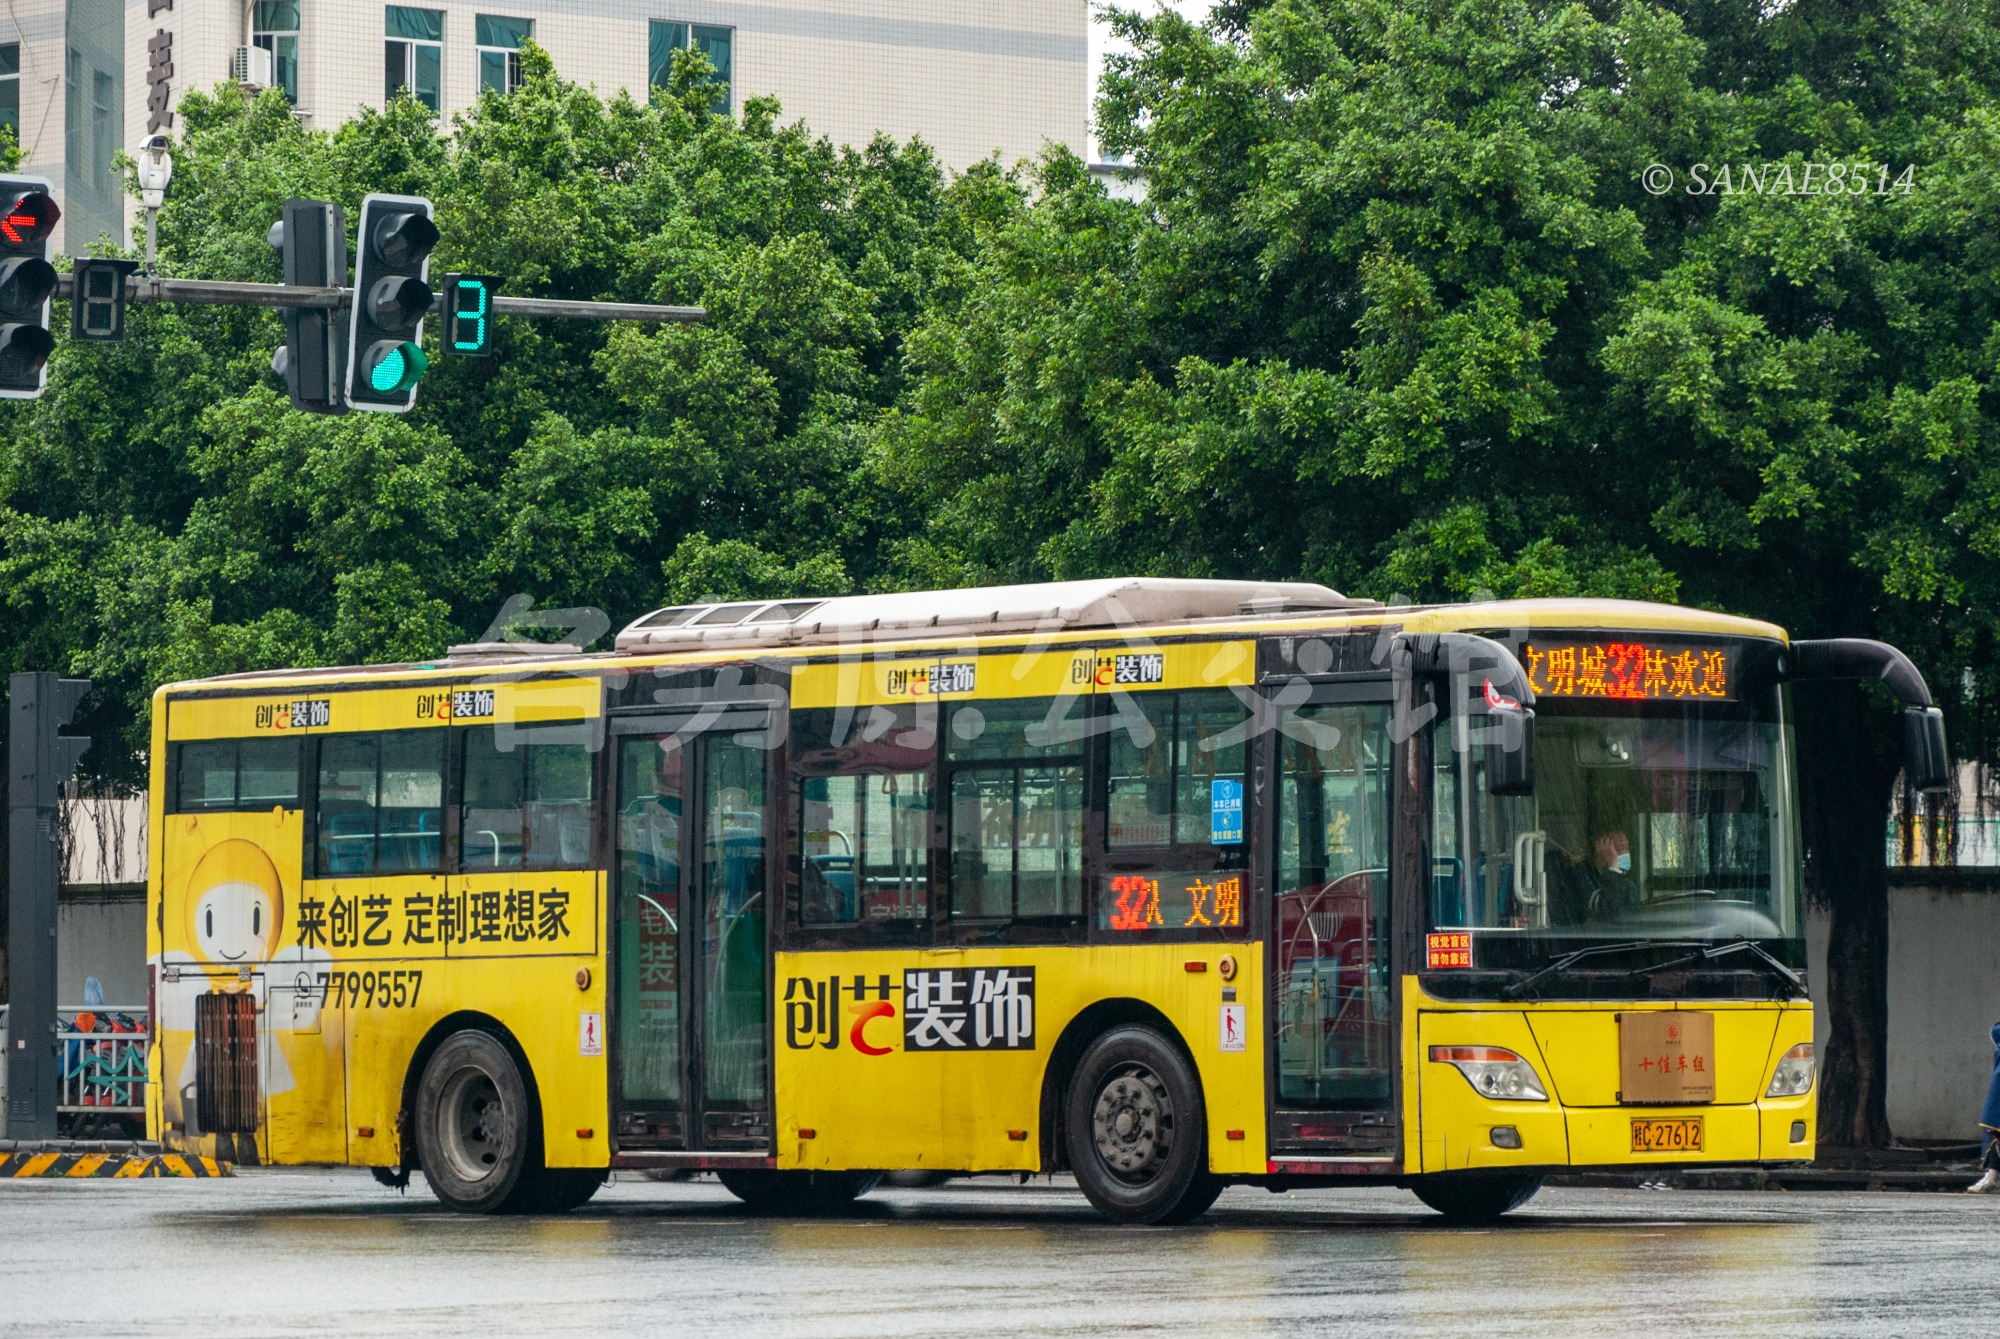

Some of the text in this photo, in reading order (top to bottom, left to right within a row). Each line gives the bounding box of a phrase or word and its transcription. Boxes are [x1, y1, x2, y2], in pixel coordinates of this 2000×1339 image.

[454, 280, 486, 350] 3
[887, 663, 976, 695] 创艺装饰
[1071, 654, 1164, 686] 创艺装饰
[255, 699, 330, 730] 创艺装饰
[417, 690, 494, 720] 创艺装饰
[296, 887, 571, 949] 来创艺 定制理想家
[1430, 935, 1470, 949] 视觉盲区
[1430, 952, 1470, 966] 请勿靠近
[316, 970, 423, 1009] 7799557
[783, 965, 1036, 1056] 创艺装饰
[1637, 1053, 1706, 1076] 十佳车组
